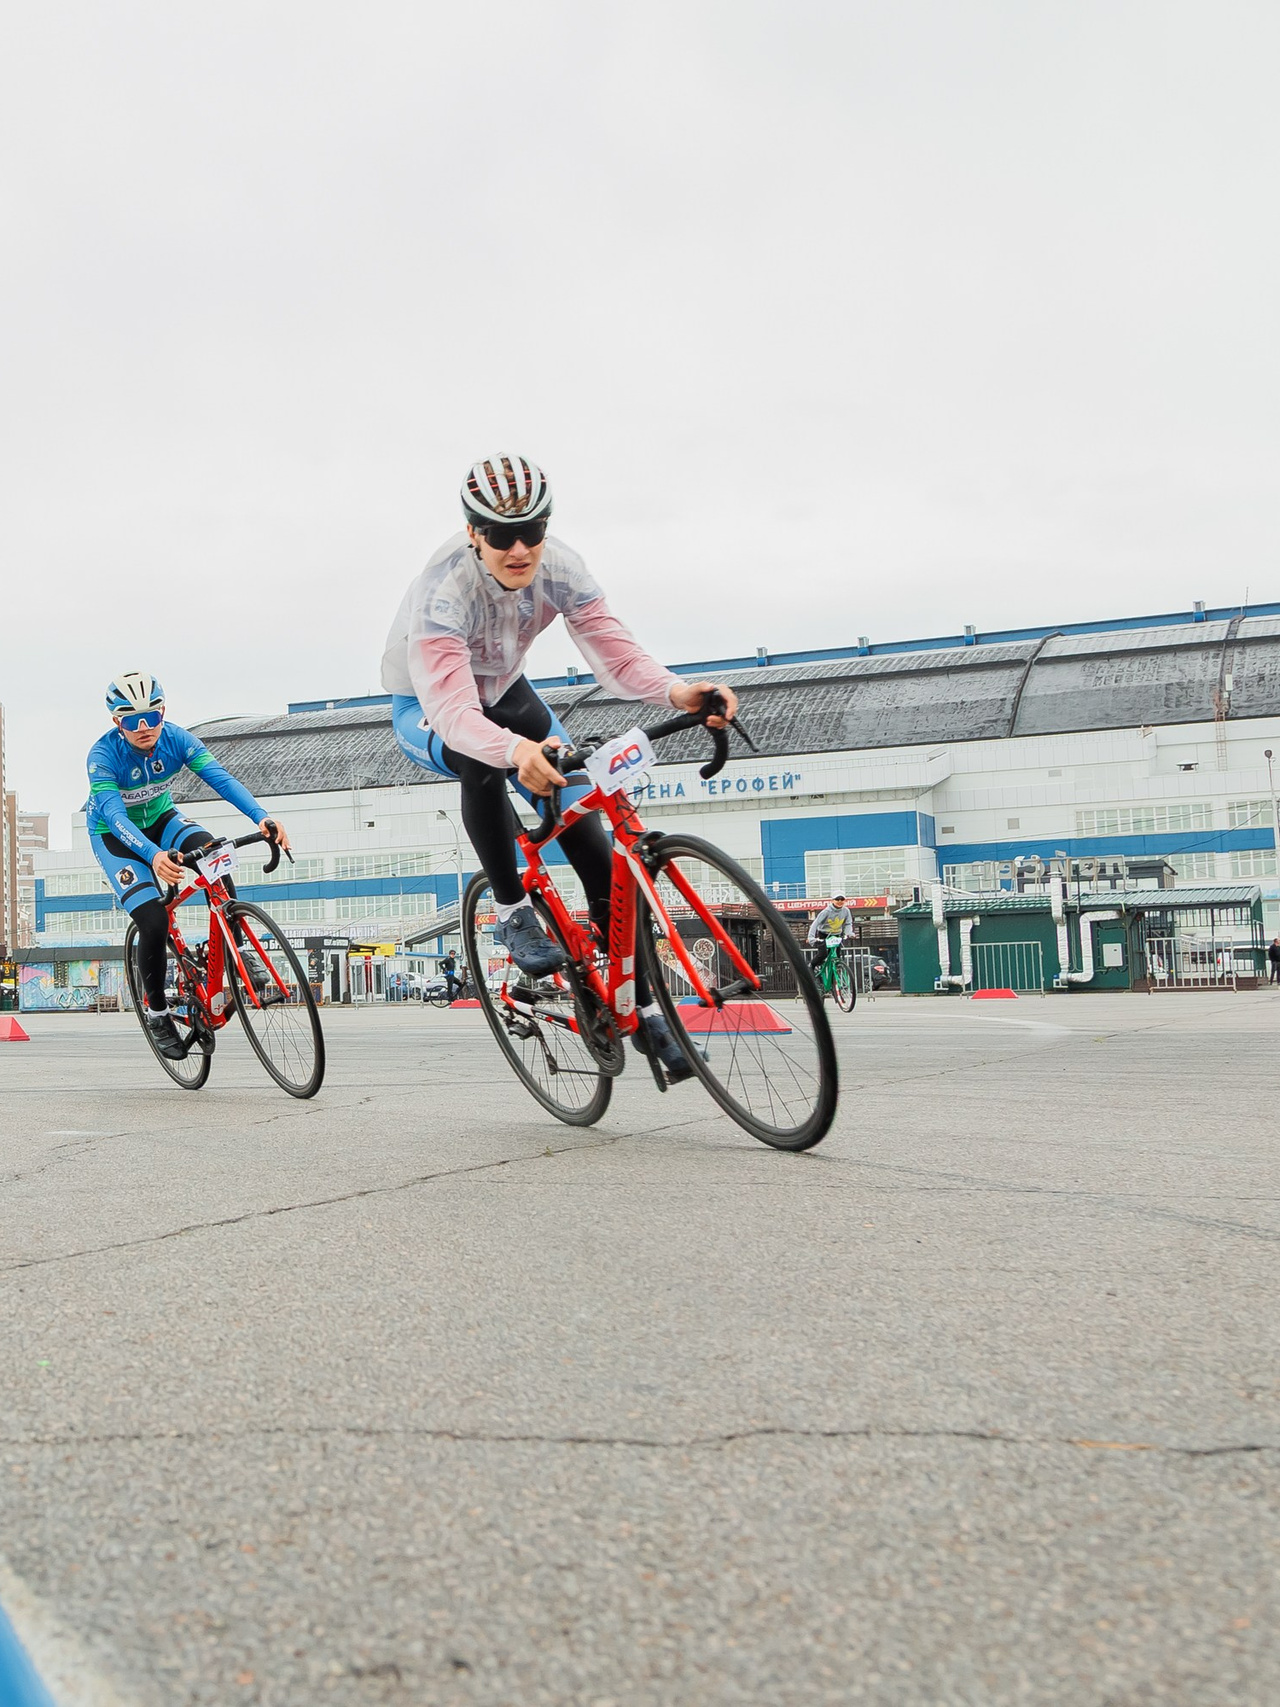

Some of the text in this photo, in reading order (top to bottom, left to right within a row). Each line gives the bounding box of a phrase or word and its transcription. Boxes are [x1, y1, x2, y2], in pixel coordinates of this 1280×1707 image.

[609, 744, 643, 775] 40
[633, 771, 801, 800] РЕНА "ЕРОФЕЙ"
[208, 854, 232, 874] 75
